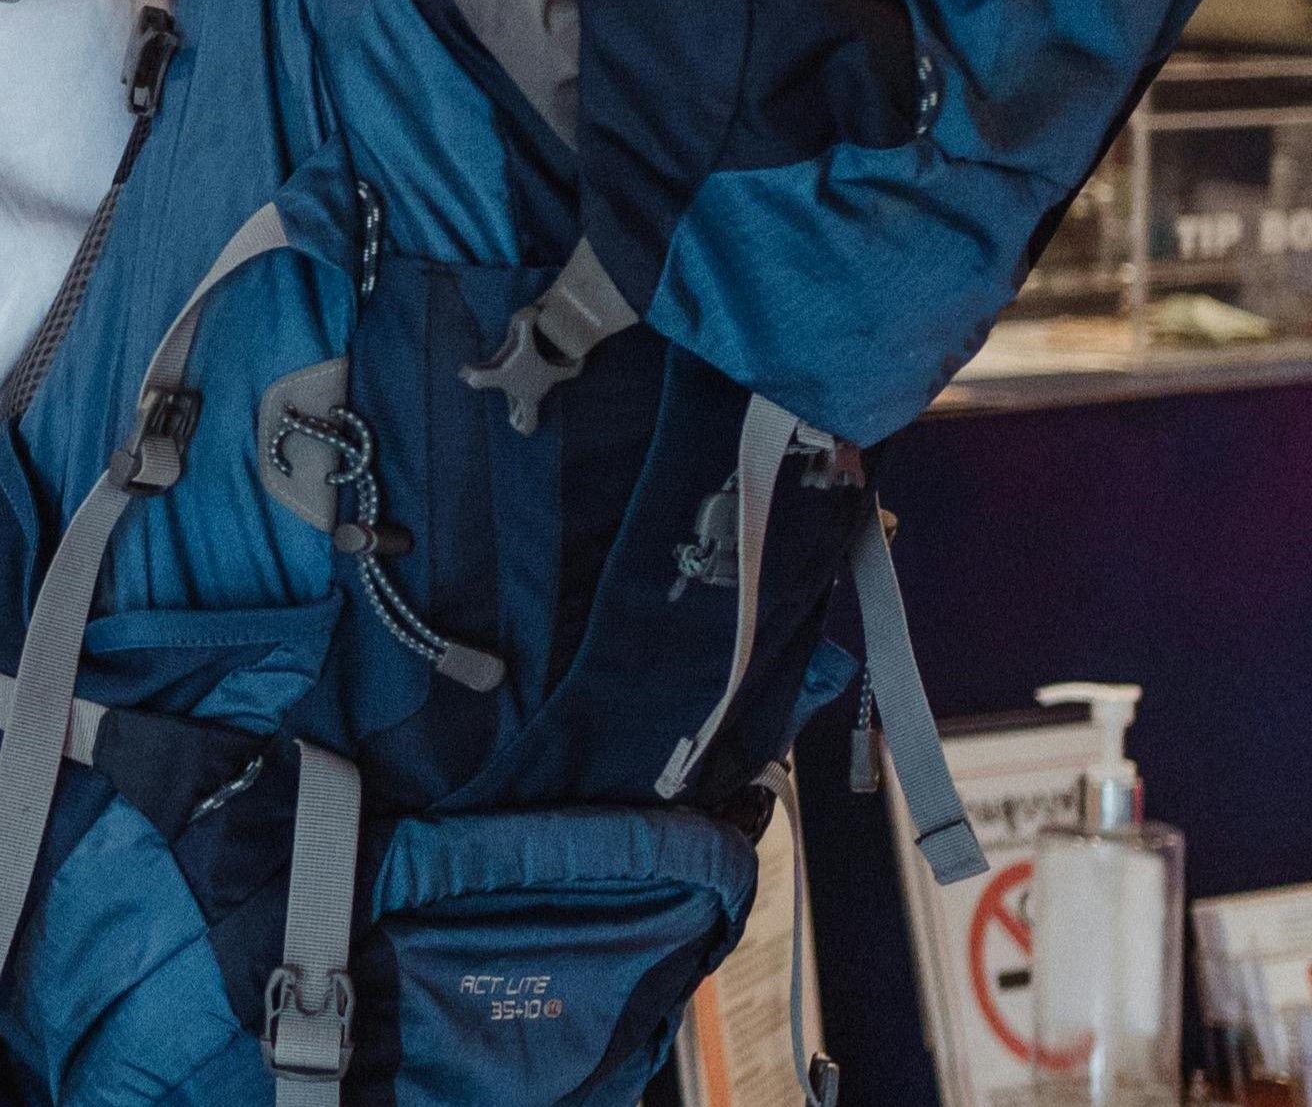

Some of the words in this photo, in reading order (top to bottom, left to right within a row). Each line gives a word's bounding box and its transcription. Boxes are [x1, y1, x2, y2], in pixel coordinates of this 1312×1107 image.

[1176, 212, 1242, 259] TIP
[460, 974, 504, 994] ACT
[506, 975, 551, 995] LITE
[491, 999, 542, 1021] 35+10
